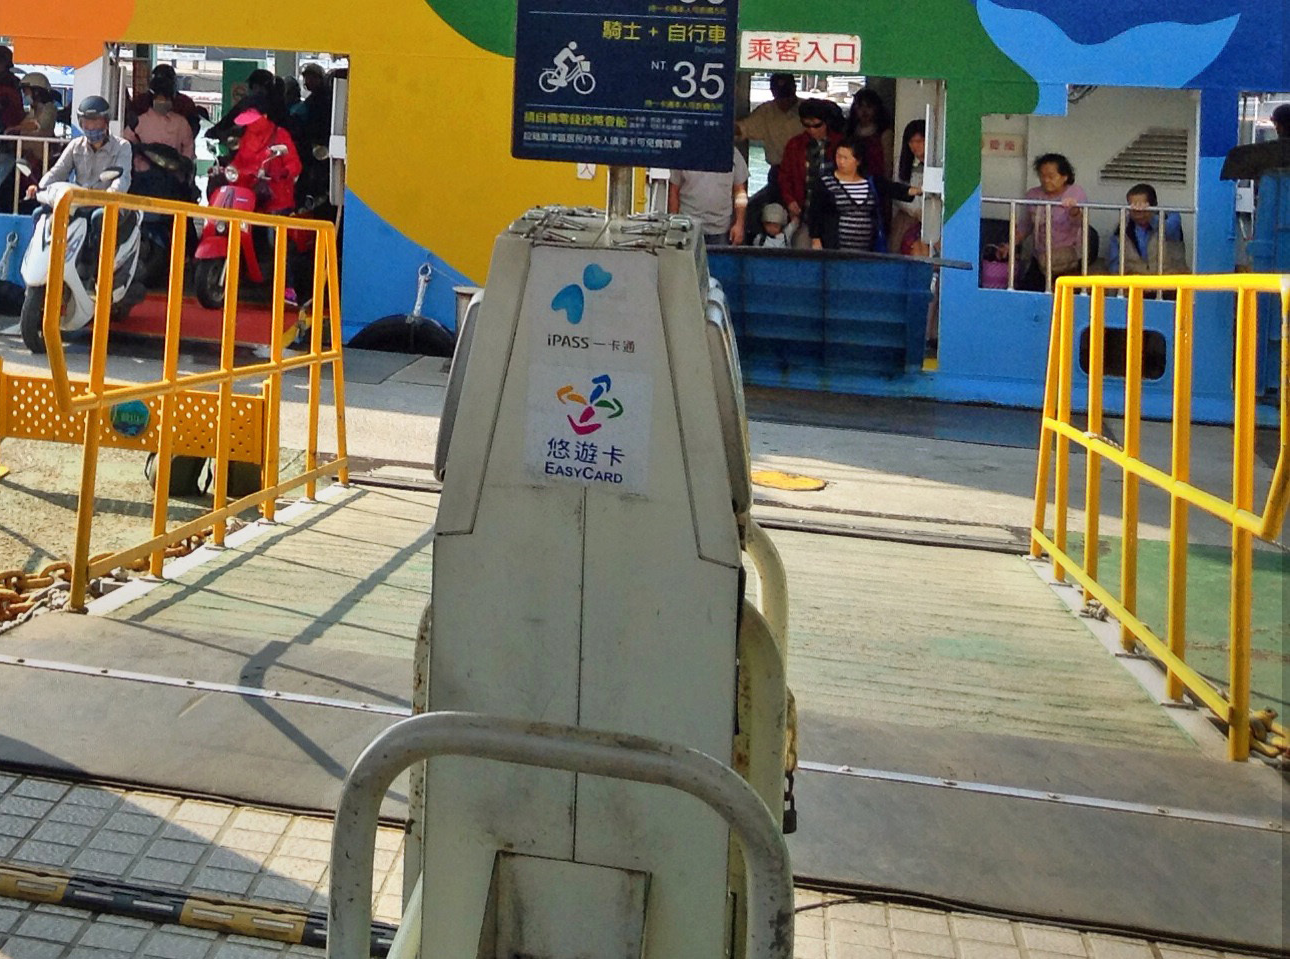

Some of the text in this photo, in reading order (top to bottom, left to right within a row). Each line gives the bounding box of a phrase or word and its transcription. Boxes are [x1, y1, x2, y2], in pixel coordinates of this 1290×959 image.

[602, 20, 642, 40] 騎士
[668, 23, 726, 44] 自行車
[747, 38, 855, 64] 乘客入口
[672, 61, 724, 100] 35
[547, 333, 635, 353] iPASS 一卡通
[547, 437, 625, 466] 悠遊卡
